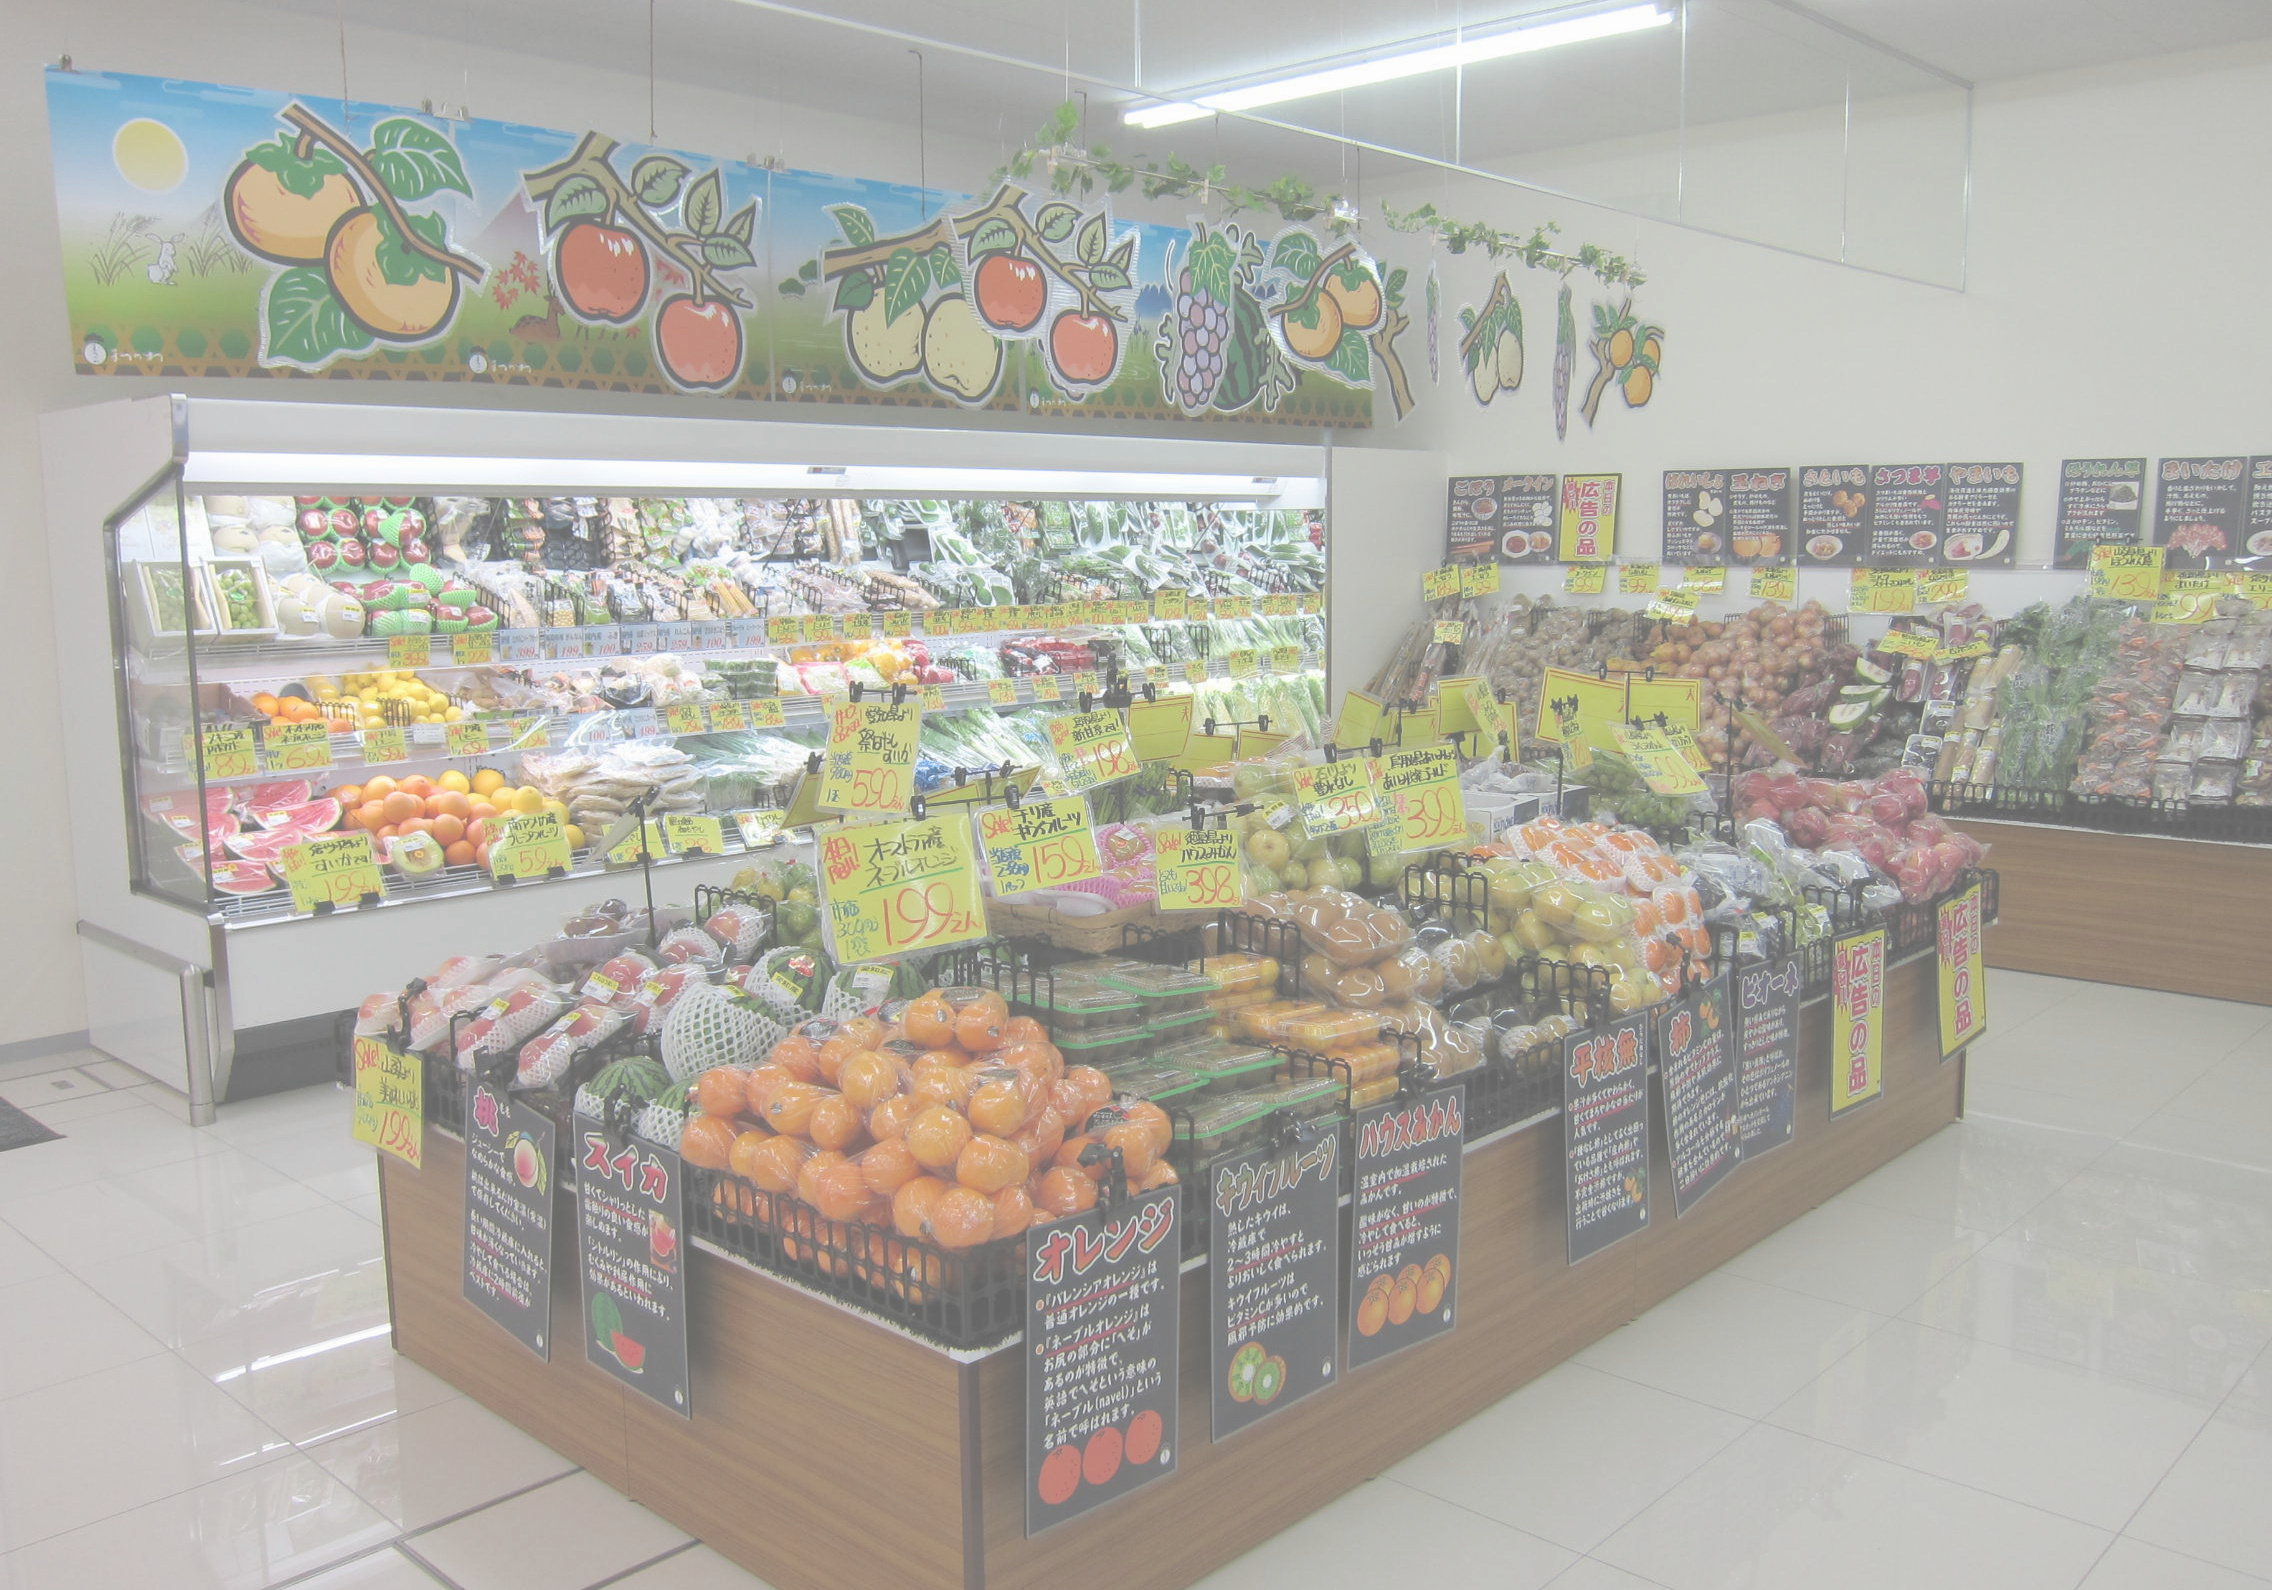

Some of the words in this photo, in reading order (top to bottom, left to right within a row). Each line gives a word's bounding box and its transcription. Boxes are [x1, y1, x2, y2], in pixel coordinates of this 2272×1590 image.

[1730, 473, 1786, 491] 玉ねぎ
[1803, 467, 1866, 487] さといも
[1873, 465, 1942, 486] さつま芋
[1950, 464, 2020, 486] やまいも
[1575, 480, 1602, 557] 広告の品
[981, 810, 1012, 839] Sale!
[1157, 832, 1181, 855] Sale!
[1181, 844, 1237, 863] ハウスみかん
[1742, 961, 1799, 1008] ピオーネ
[1951, 902, 1973, 1040] 広告の品
[1847, 941, 1870, 1097] 広告の品
[354, 1038, 380, 1071] Sale!
[1570, 1027, 1638, 1088] 平核無
[1359, 1095, 1461, 1159] ハウスみかん
[583, 1132, 668, 1203] スイカ
[1216, 1134, 1336, 1217] キウイフルーツ
[1360, 1183, 1402, 1205] みかんです。
[1034, 1197, 1173, 1284] オレンジ
[1228, 1227, 1266, 1253] 冷蔵庫で
[1045, 1278, 1164, 1330] 普通オレンジの一種です。
[1227, 1283, 1308, 1328] ビタミンCが多いので
[1228, 1271, 1294, 1311] キウイフルーツは
[1227, 1295, 1324, 1346] 風邪予防に効果的です。
[1044, 1321, 1151, 1370] お尻の部分に「へそ」が
[1044, 1358, 1156, 1413] 英語でへそという意味の
[1044, 1404, 1134, 1449] 名前で呼ばれます。
